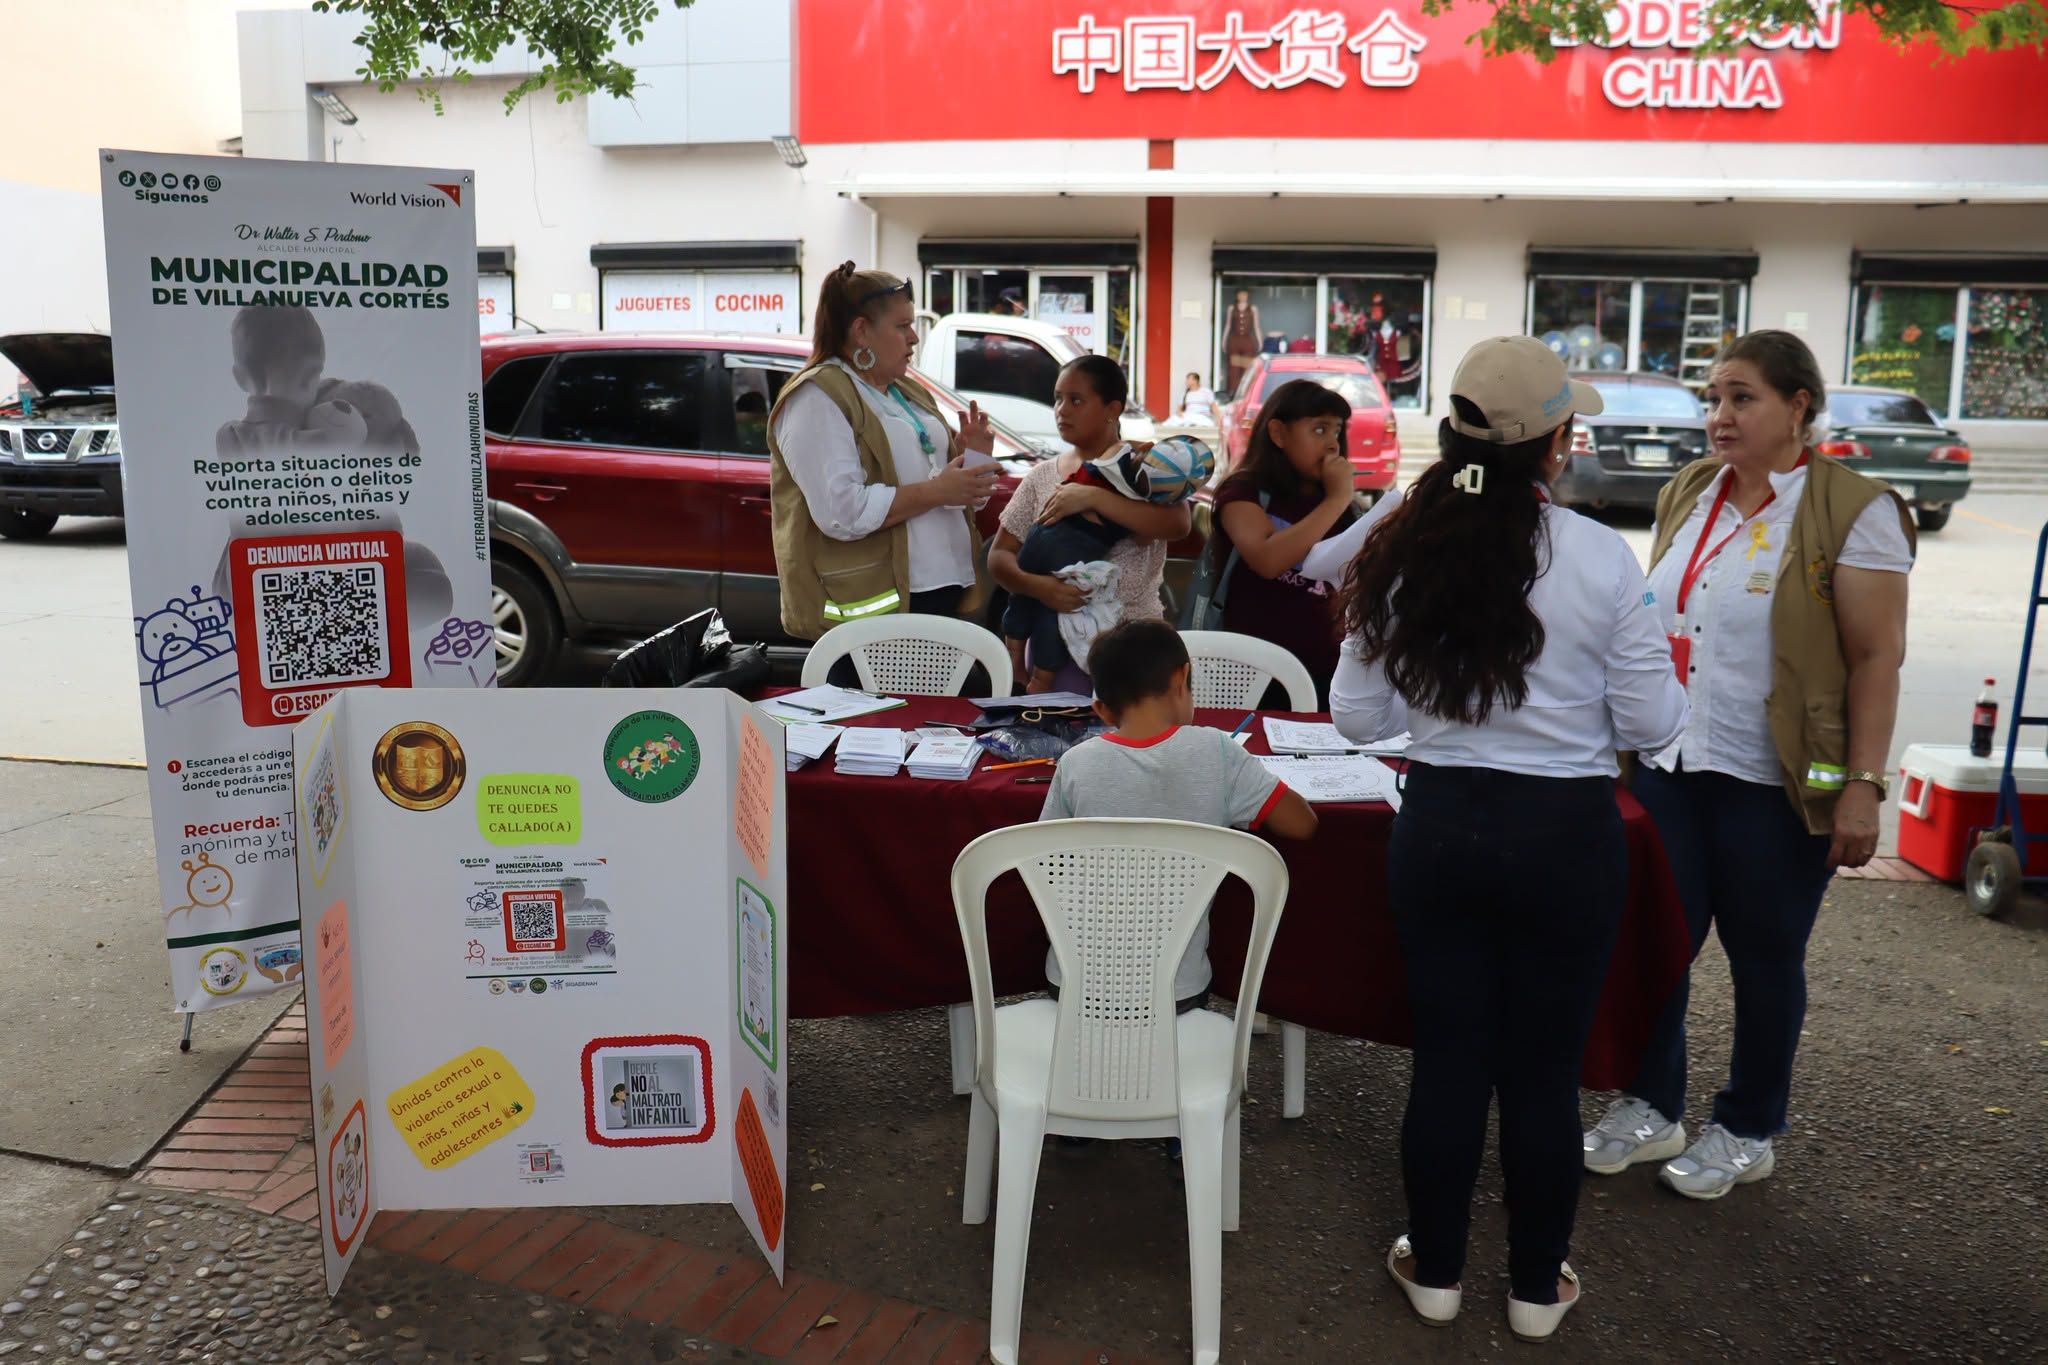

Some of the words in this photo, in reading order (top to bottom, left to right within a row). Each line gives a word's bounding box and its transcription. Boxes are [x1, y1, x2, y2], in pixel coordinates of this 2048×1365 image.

[1051, 10, 1428, 93] 中国大货仓
[1602, 57, 1783, 109] CHINA
[135, 189, 209, 204] Síguenos
[350, 191, 397, 207] World
[400, 194, 446, 209] Vision
[264, 225, 301, 241] Walter
[324, 228, 372, 244] Perdomo
[256, 243, 300, 252] ALCALDE
[303, 245, 356, 254] MUNICIPAL
[150, 256, 449, 288] MUNICIPALIDAD
[152, 287, 188, 305] DE
[194, 289, 353, 308] VILLANUEVA
[359, 288, 450, 309] CORTÉS
[615, 296, 691, 312] JUGUETES
[714, 294, 784, 313] COCINA
[193, 458, 276, 477] Reporta
[281, 454, 393, 471] situaciones
[398, 452, 422, 467] de
[205, 473, 325, 492] vulneración
[330, 475, 343, 487] o
[348, 471, 413, 486] delitos
[468, 391, 486, 561] #TIERRAQUEENDULZAAHONDURAS
[205, 494, 272, 510] contra
[278, 490, 337, 507] niños,
[342, 488, 394, 504] niñas
[398, 489, 410, 505] y
[245, 508, 381, 526] adolescentes.
[247, 543, 324, 565] DENUNCIA
[325, 540, 389, 561] VIRTUAL
[186, 756, 236, 769] Escanea
[239, 752, 249, 762] el
[252, 749, 292, 761] código
[181, 773, 189, 782] y
[192, 764, 253, 779] accederás
[256, 764, 263, 772] a
[266, 761, 281, 771] un
[182, 779, 221, 792] donde
[224, 774, 265, 788] podrás
[216, 790, 229, 798] tu
[232, 782, 290, 797] denuncia.
[487, 784, 551, 795] DENUNCIA
[555, 784, 572, 795] NO
[488, 803, 505, 814] TE
[507, 803, 559, 815] QUEDES
[184, 815, 280, 838] Recuerda:
[488, 821, 572, 833] CALLADO(A)
[181, 835, 263, 855] anónima
[267, 833, 277, 848] y
[235, 850, 258, 865] de
[495, 861, 563, 870] MUNICIPALIDAD
[630, 1062, 658, 1075] DECILE
[391, 1088, 432, 1117] Unidos
[433, 1065, 472, 1093] contra
[470, 1057, 485, 1069] la
[631, 1075, 647, 1093] NO
[648, 1075, 664, 1092] AL
[404, 1099, 455, 1133] violencia
[455, 1074, 492, 1103] sexual
[493, 1070, 502, 1080] a
[632, 1092, 682, 1108] MALTRATO
[451, 1106, 481, 1129] niñas
[482, 1101, 491, 1113] y
[632, 1107, 690, 1126] INFANTIL
[430, 1117, 503, 1166] adolescentes
